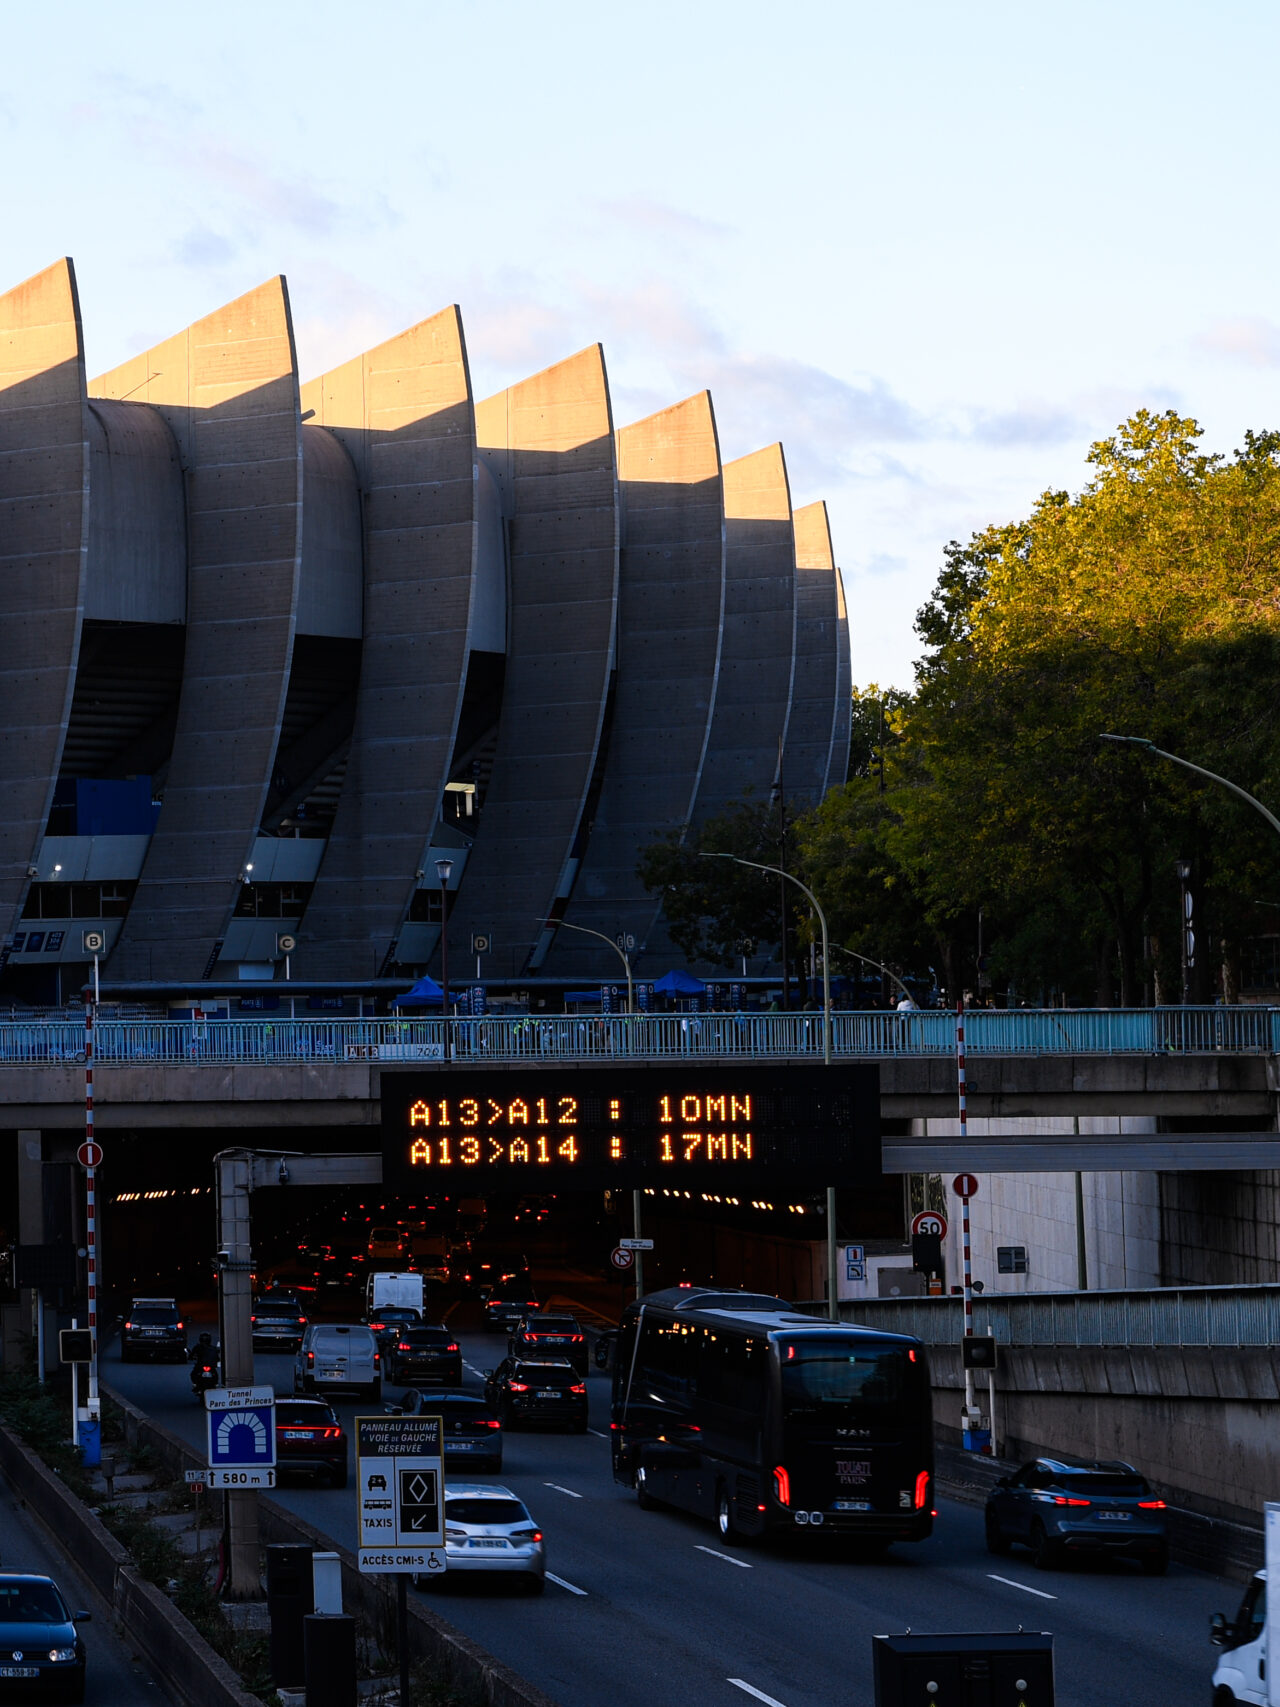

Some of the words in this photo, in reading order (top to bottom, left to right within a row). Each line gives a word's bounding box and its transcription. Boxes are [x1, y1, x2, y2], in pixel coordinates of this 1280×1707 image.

[90, 937, 98, 947] B
[282, 938, 291, 948] C
[477, 939, 485, 948] D
[410, 1098, 578, 1126] A13>A12
[659, 1095, 751, 1122] 10MN
[411, 1135, 578, 1164] A13>A14
[660, 1133, 752, 1161] 17MN
[920, 1222, 940, 1235] 50
[227, 1390, 252, 1398] Tunnel
[209, 1400, 225, 1408] Parc
[244, 1397, 272, 1405] Princes
[360, 1423, 401, 1432] PANNEAU
[403, 1421, 438, 1432] ALLUMÉ
[369, 1433, 389, 1442] VOIE
[400, 1433, 437, 1442] GAUCHE
[377, 1444, 423, 1453] RÉSERVÉE
[223, 1473, 247, 1483] 580
[364, 1518, 393, 1527] TAXIS
[362, 1554, 394, 1565] ACCÈS
[396, 1556, 424, 1565] CMI-S
